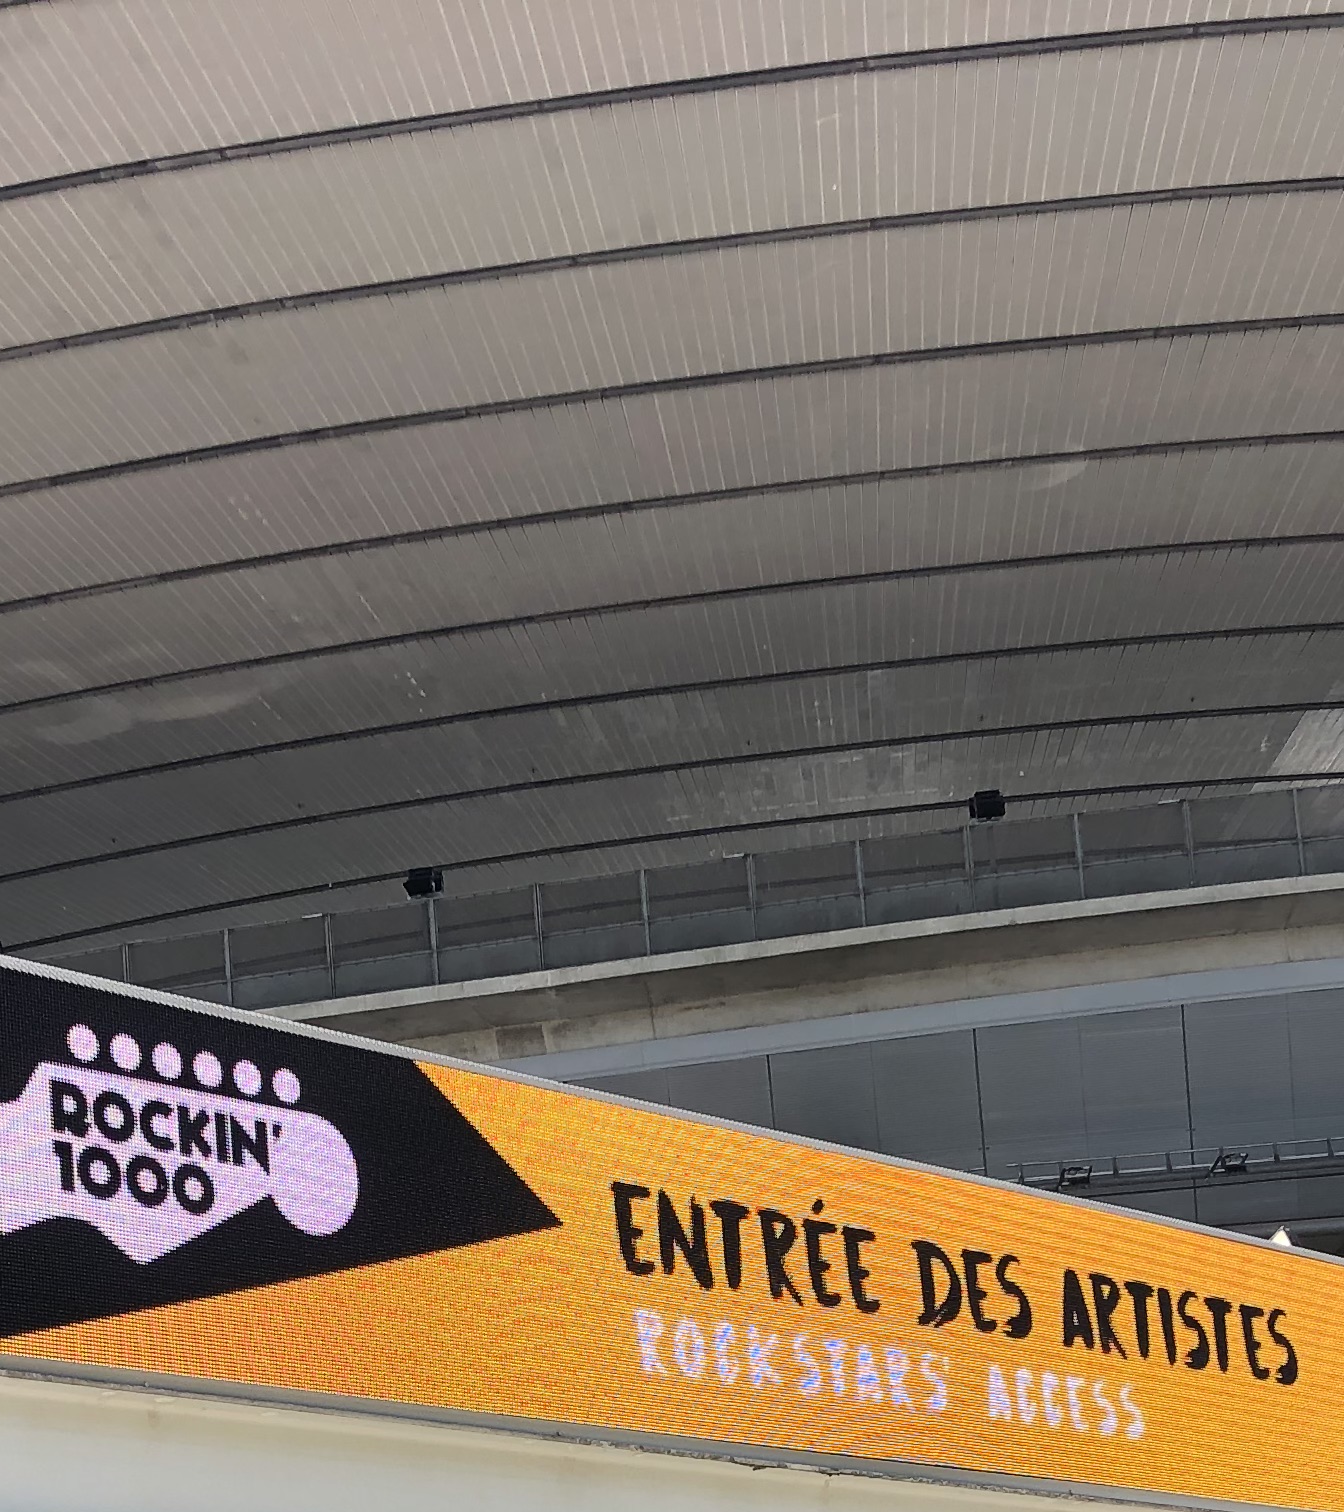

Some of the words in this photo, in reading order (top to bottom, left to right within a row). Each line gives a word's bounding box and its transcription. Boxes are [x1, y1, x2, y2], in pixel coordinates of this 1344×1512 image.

[49, 1079, 282, 1176] ROCKIN'
[52, 1139, 215, 1214] 1000
[611, 1181, 880, 1313] ENTRÉE
[910, 1239, 1032, 1339] DES
[1063, 1268, 1298, 1385] ARTISTES
[987, 1364, 1145, 1440] ACCESS
